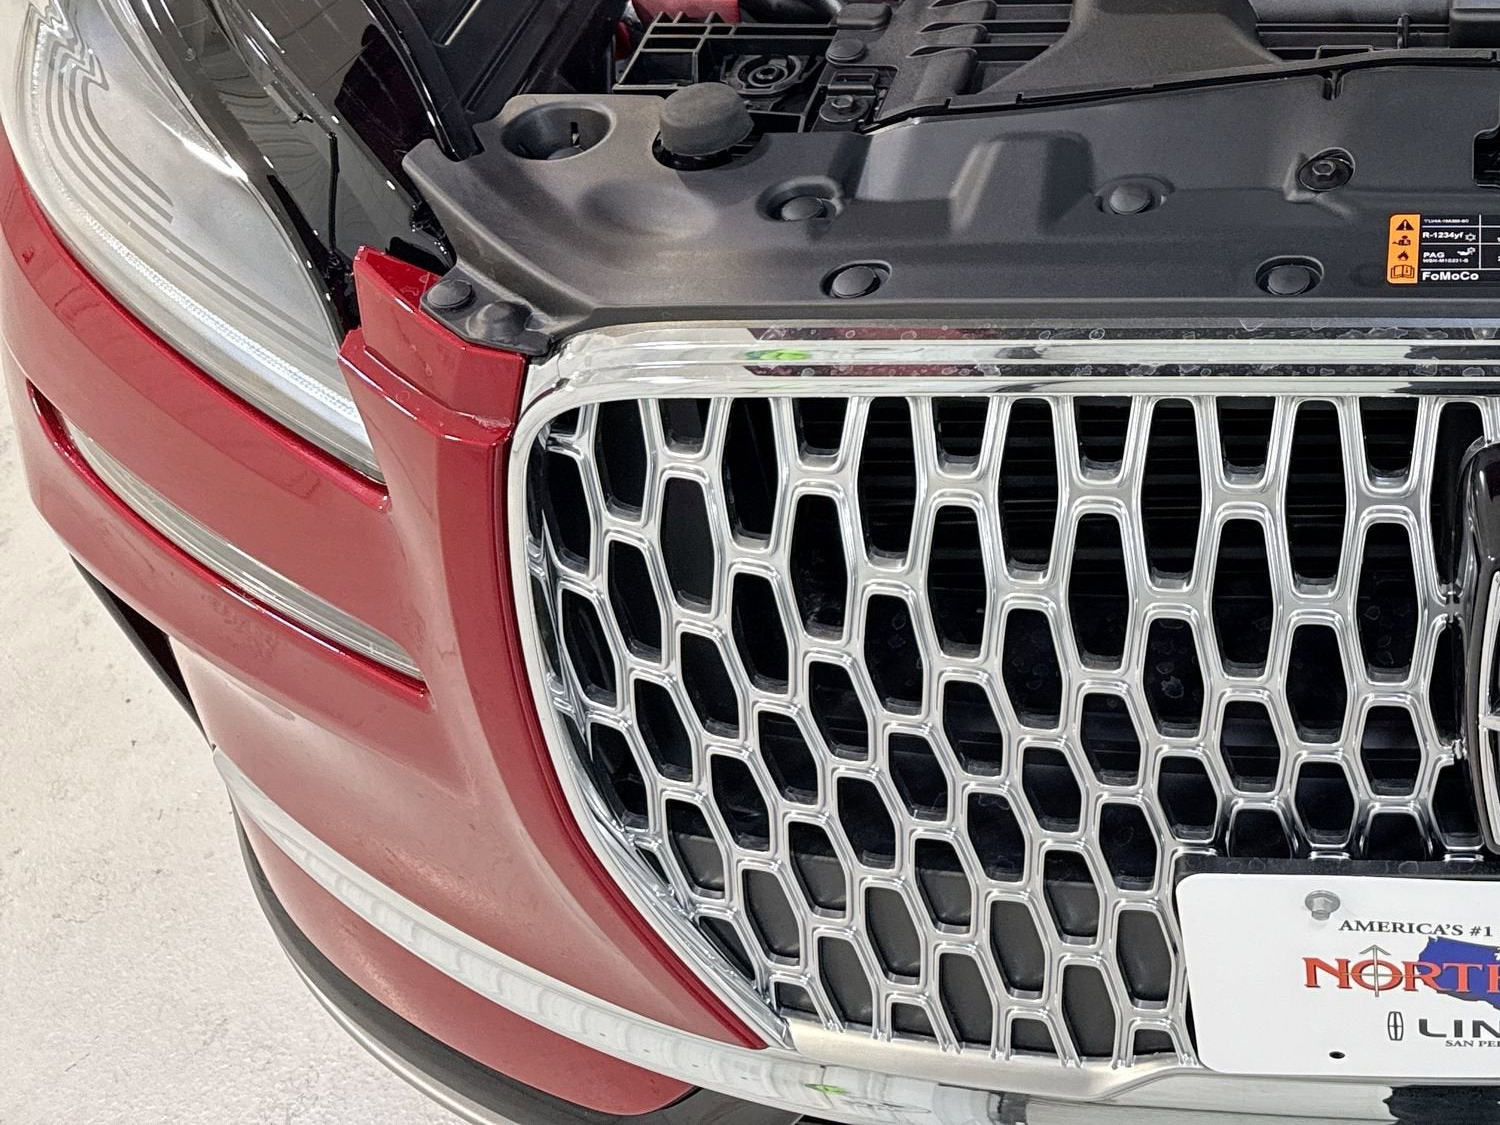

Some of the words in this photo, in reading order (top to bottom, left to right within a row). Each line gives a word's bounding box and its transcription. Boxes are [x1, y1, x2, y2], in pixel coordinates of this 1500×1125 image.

[1422, 231, 1464, 240] R-1234yf
[1422, 271, 1480, 281] FoMoCo
[1338, 919, 1464, 936] AMERICA'S
[1470, 925, 1493, 937] #1
[1445, 1039, 1476, 1048] SAN
